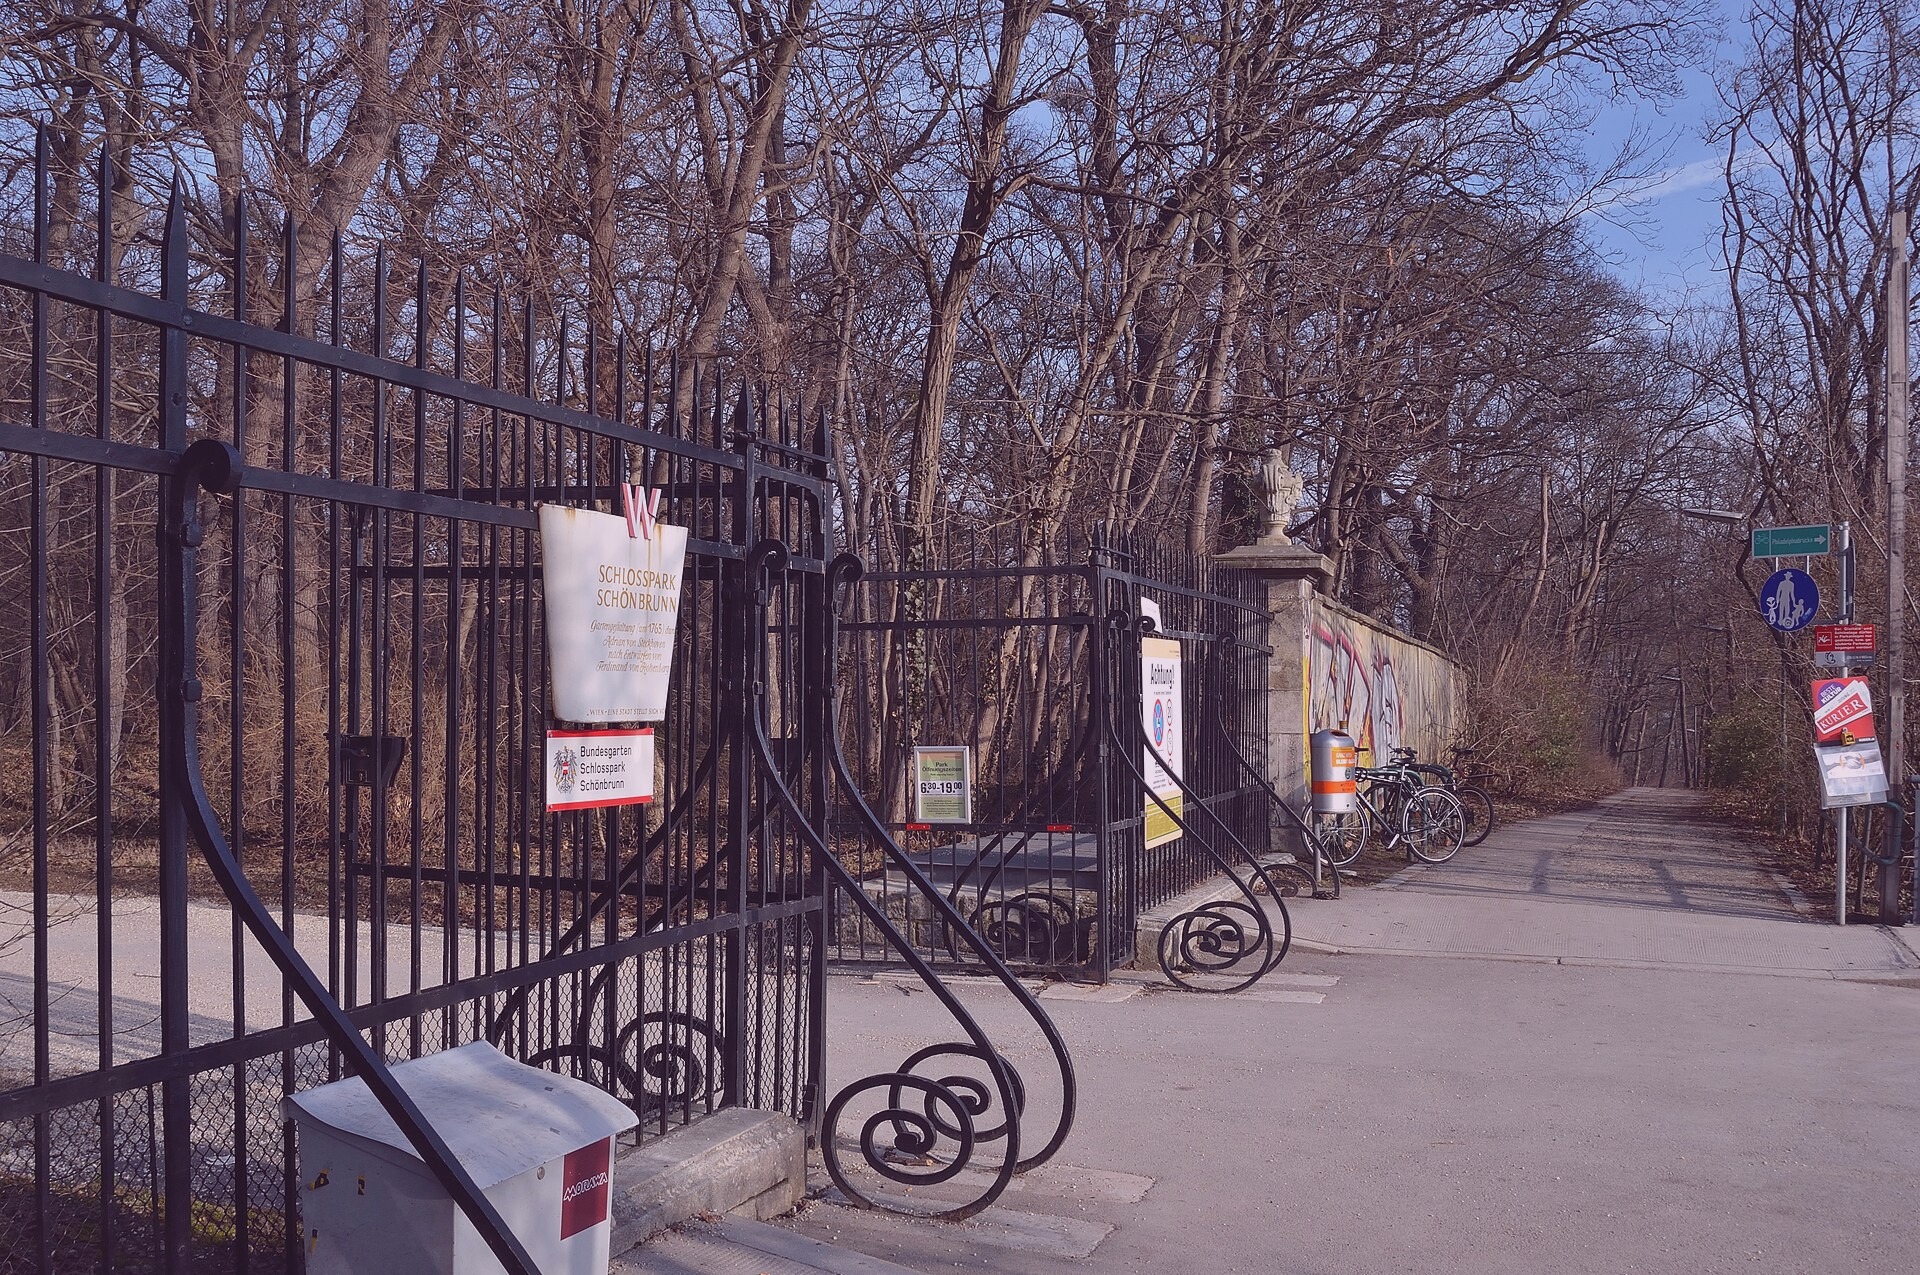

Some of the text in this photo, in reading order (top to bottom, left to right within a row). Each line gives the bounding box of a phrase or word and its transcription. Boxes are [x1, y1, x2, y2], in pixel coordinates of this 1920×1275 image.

[598, 564, 676, 590] SCHLOSSPARK
[597, 588, 677, 613] SCHÖNBRUNN
[1150, 662, 1175, 690] Achtung!
[1820, 683, 1836, 699] BESTE
[1820, 686, 1842, 704] KULTUR
[619, 708, 633, 716] STADT
[1819, 699, 1864, 729] KURIER
[580, 745, 632, 759] Bundesgarten
[580, 761, 626, 776] Schlosspark
[580, 778, 625, 792] Schönbrunn
[562, 1171, 609, 1203] MORAWA
